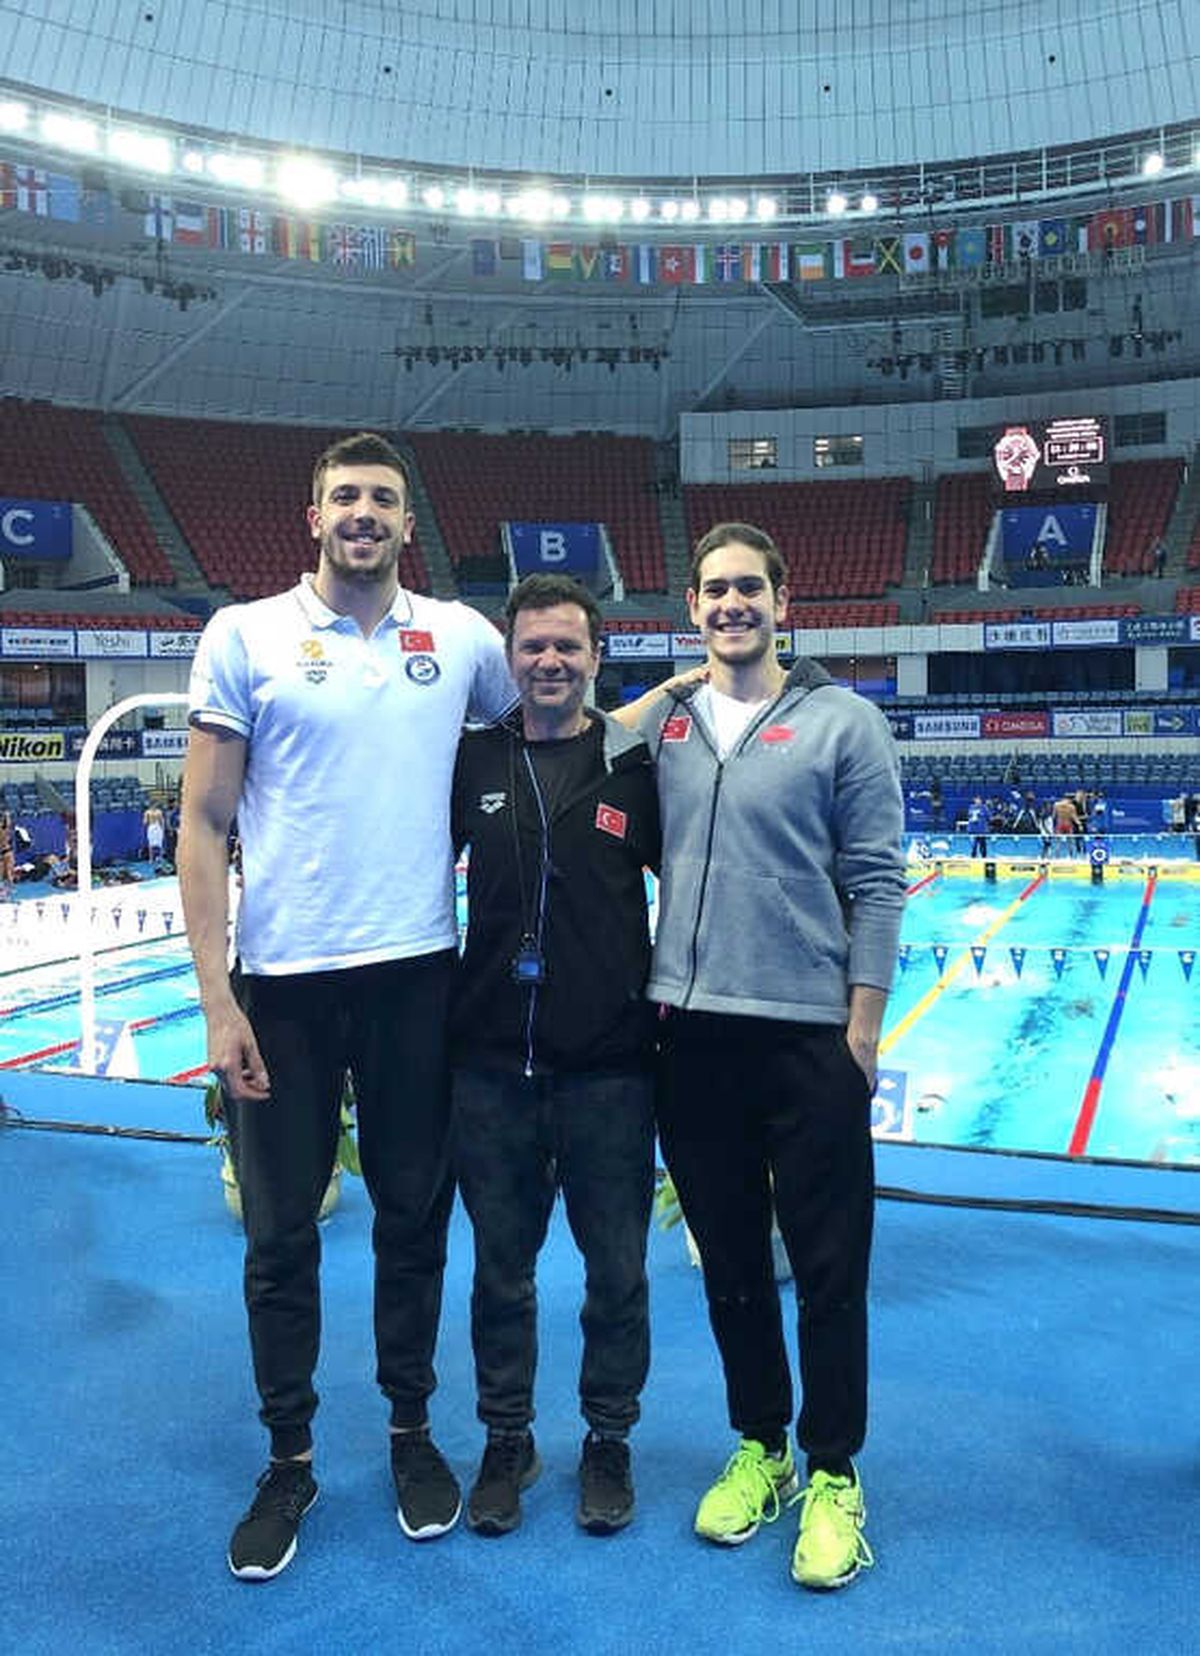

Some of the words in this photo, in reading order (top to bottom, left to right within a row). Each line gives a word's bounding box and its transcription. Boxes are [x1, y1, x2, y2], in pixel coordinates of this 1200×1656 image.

[2, 508, 36, 546] C
[1037, 515, 1068, 545] A
[540, 531, 568, 562] B
[917, 719, 978, 732] SAMSUNG
